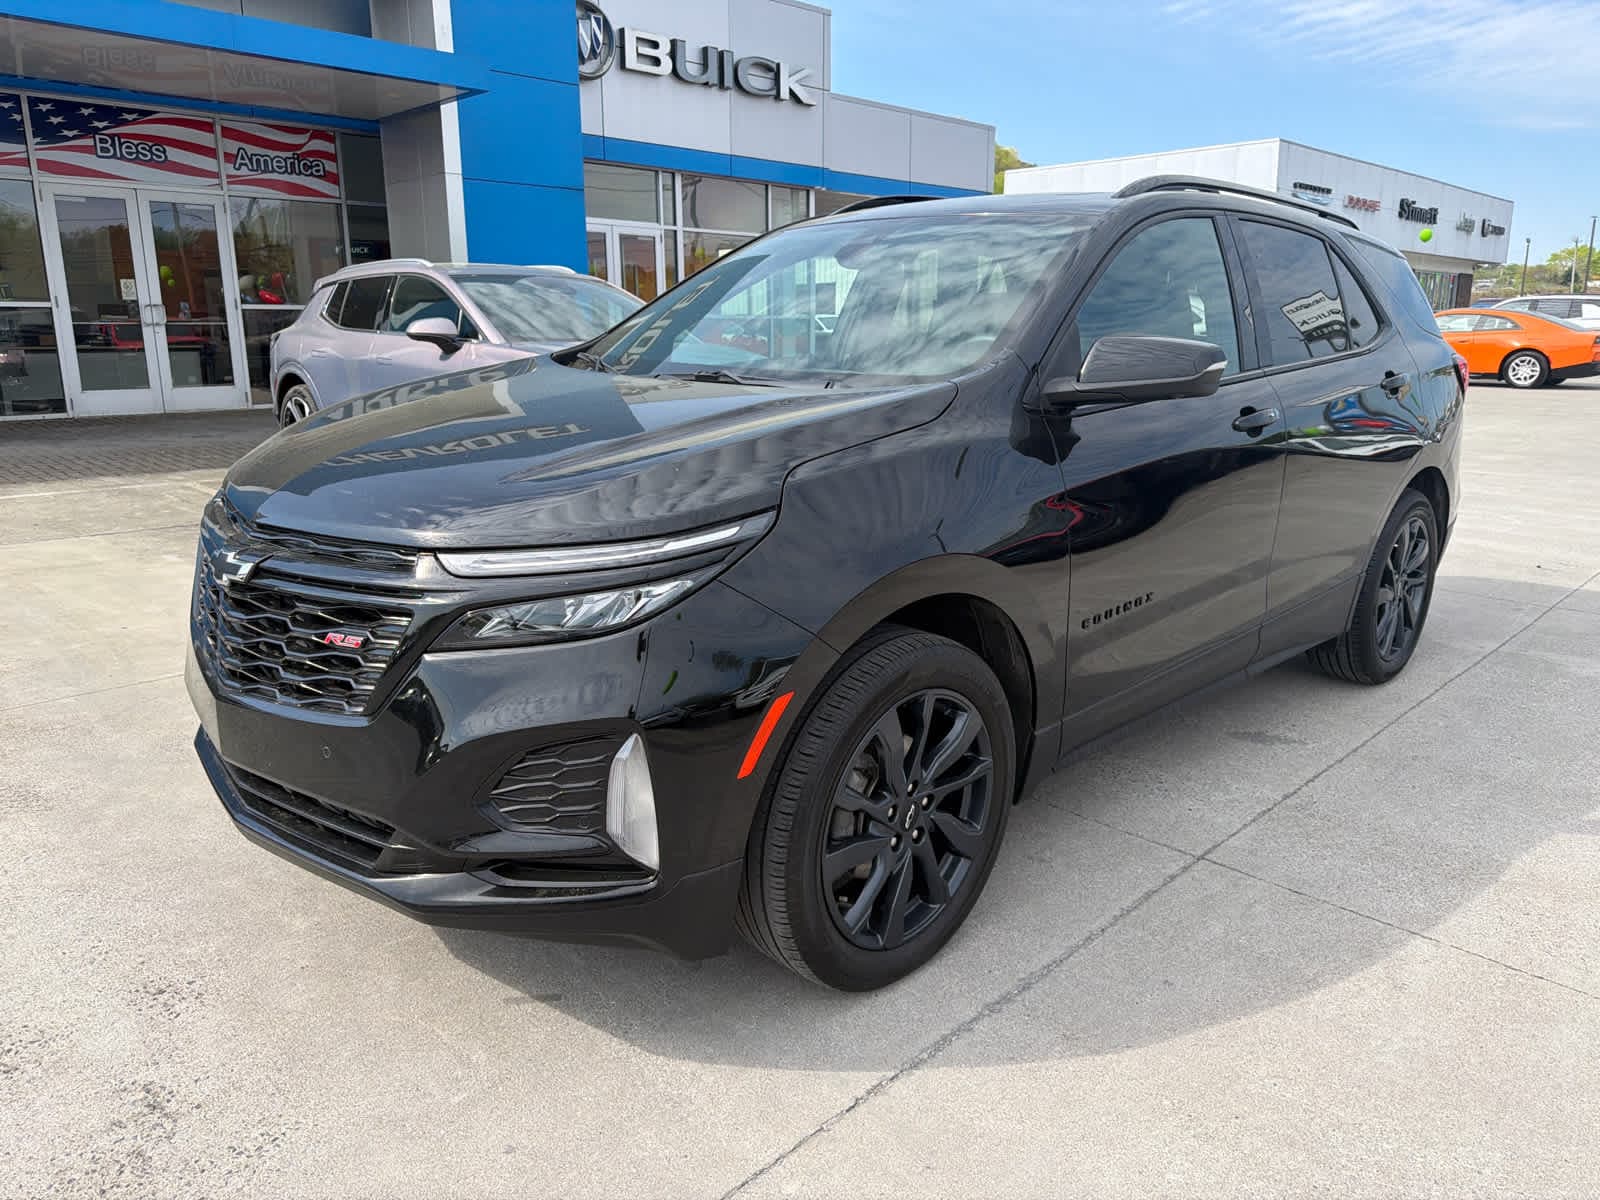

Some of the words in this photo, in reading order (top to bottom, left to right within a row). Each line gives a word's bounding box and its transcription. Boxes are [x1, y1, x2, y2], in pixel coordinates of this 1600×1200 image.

[617, 27, 816, 106] BUICK
[94, 134, 167, 164] Bless
[233, 147, 327, 177] America
[1081, 591, 1155, 630] EQUINOX
[324, 632, 364, 649] RS
